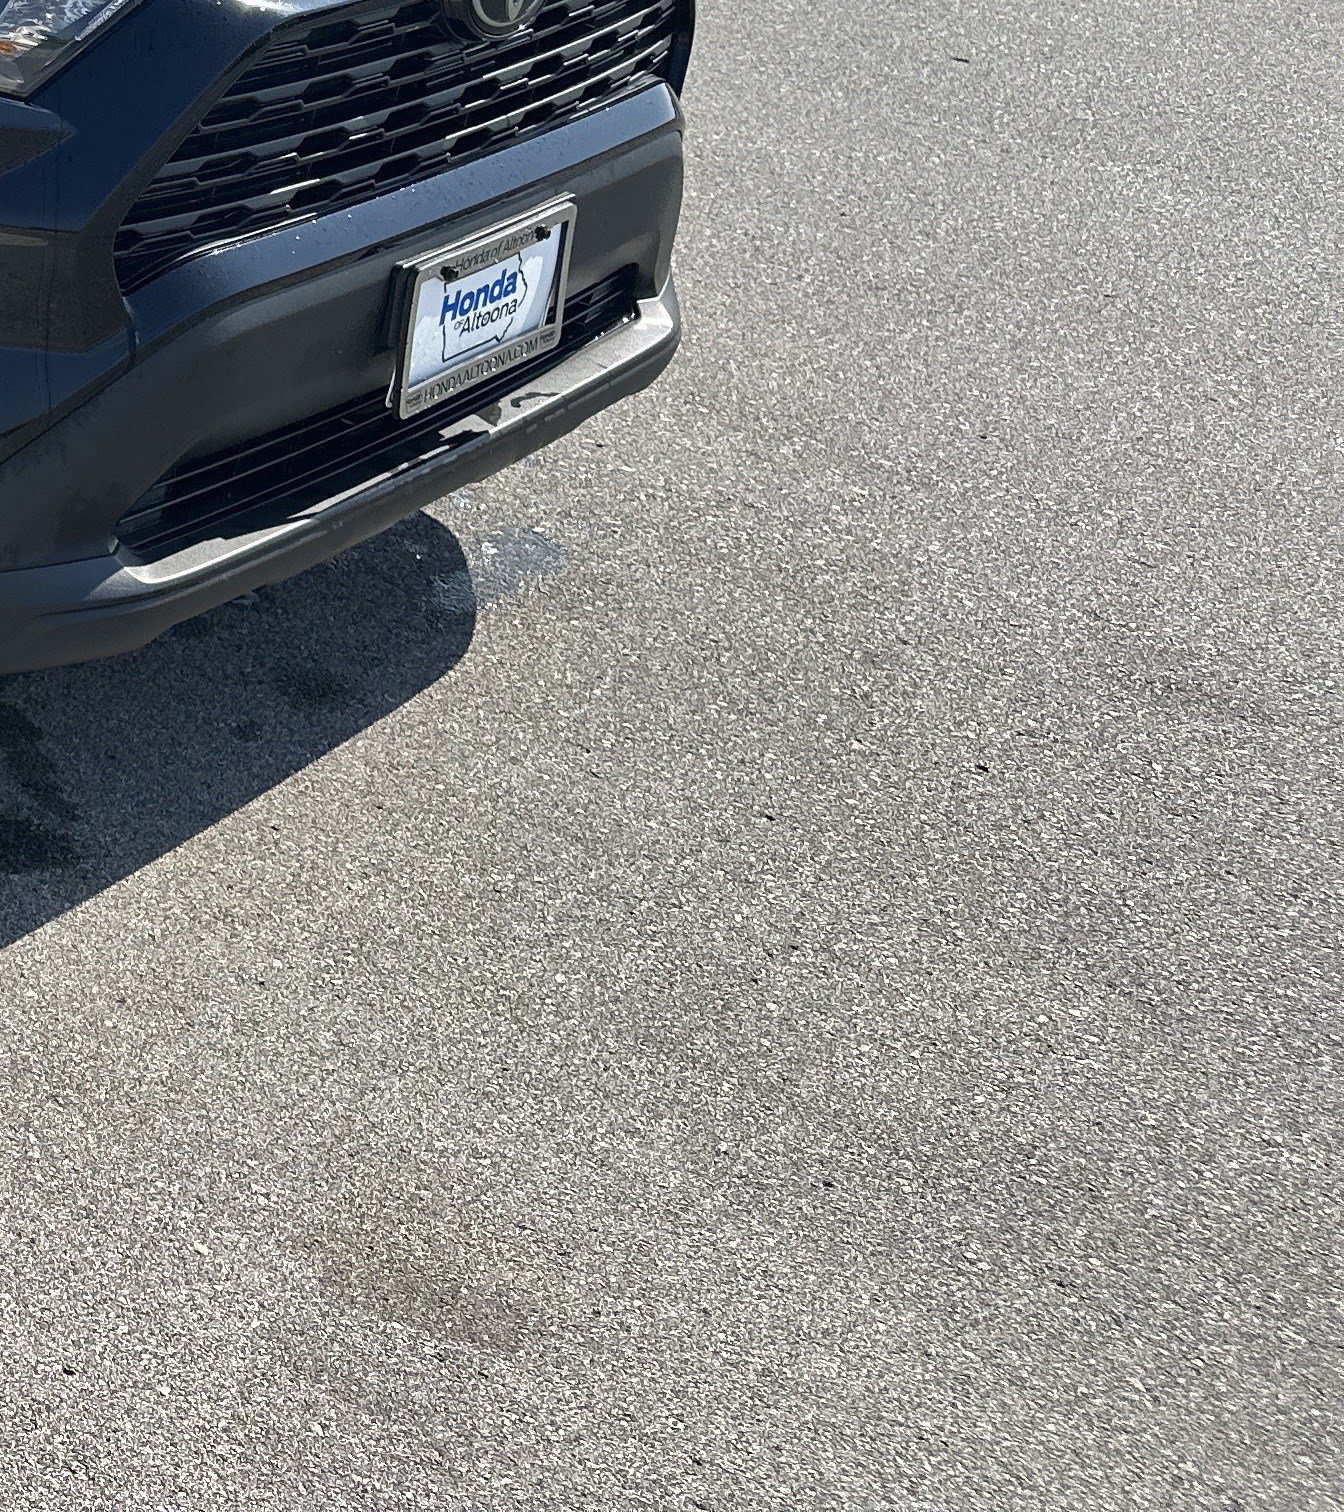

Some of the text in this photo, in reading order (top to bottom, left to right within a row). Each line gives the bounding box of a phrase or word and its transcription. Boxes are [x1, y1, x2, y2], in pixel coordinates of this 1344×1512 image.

[503, 230, 536, 253] Altoon
[439, 268, 518, 326] Honda
[459, 298, 519, 338] Altoona
